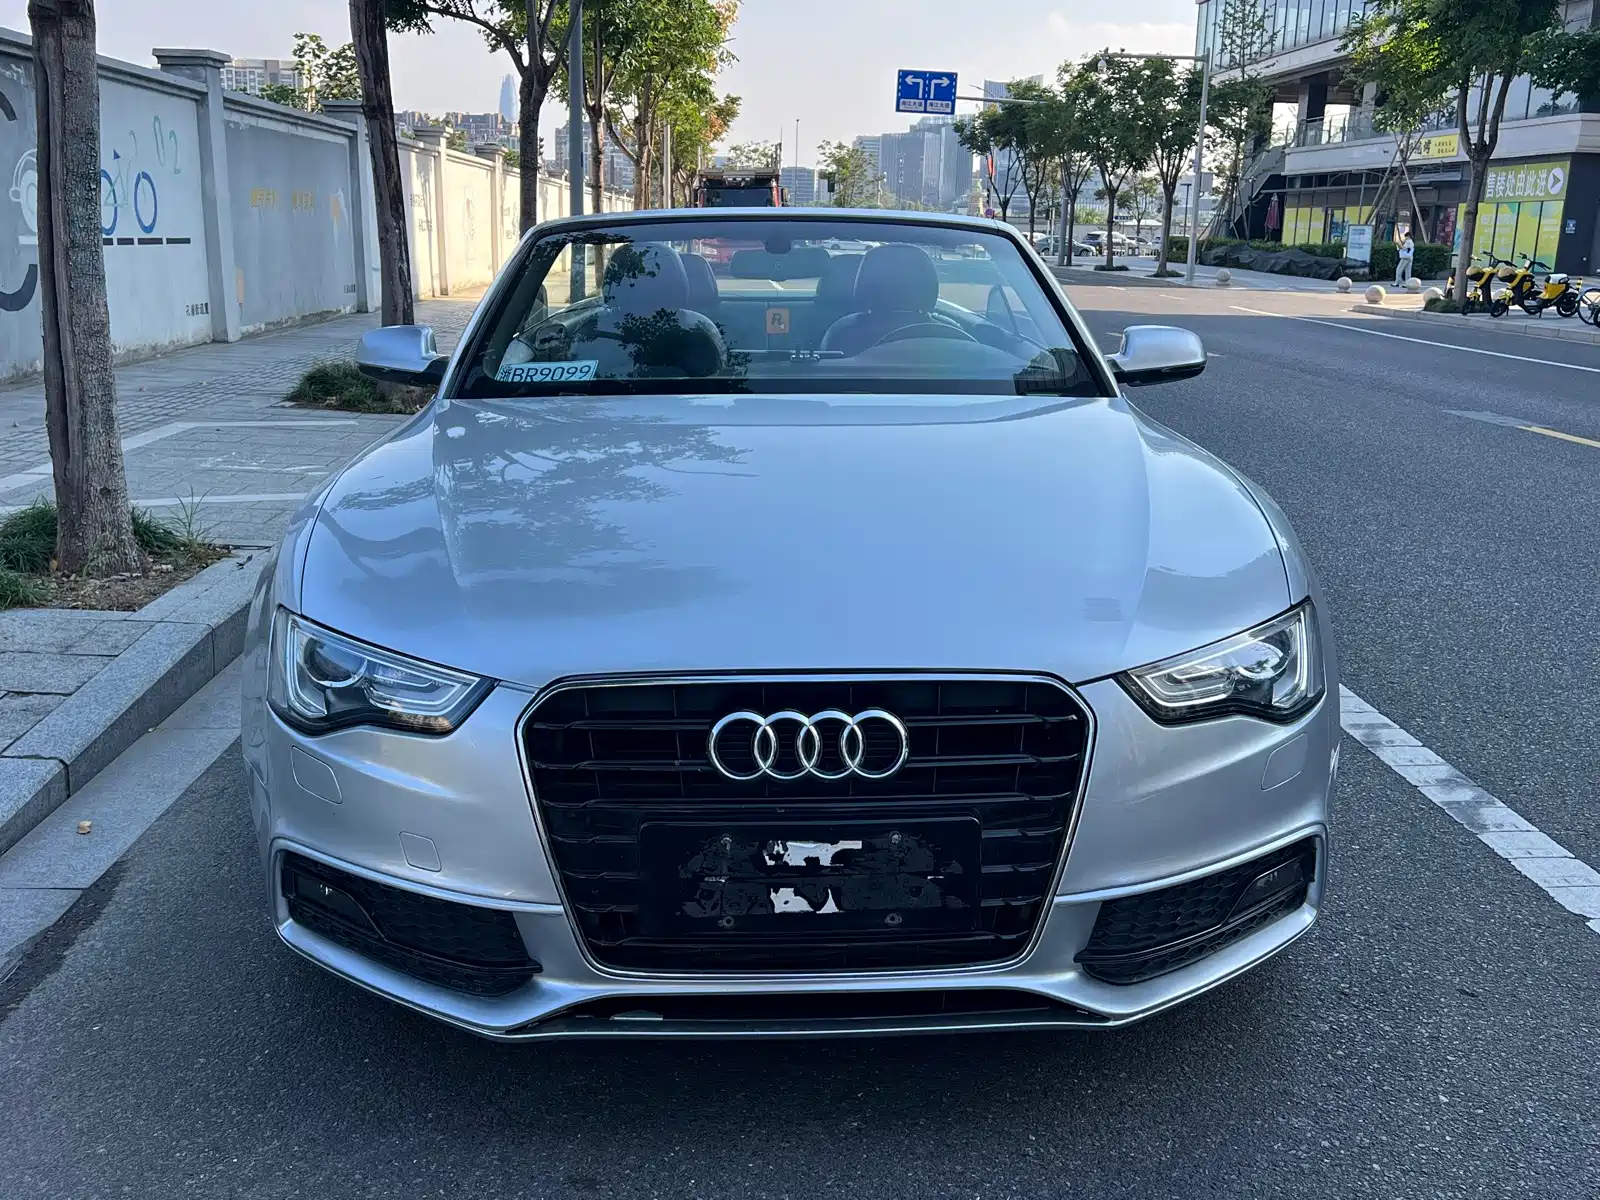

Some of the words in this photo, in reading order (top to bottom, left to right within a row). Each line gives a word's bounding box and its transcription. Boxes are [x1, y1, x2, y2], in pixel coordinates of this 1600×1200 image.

[1486, 169, 1547, 198] 售楼处由此进
